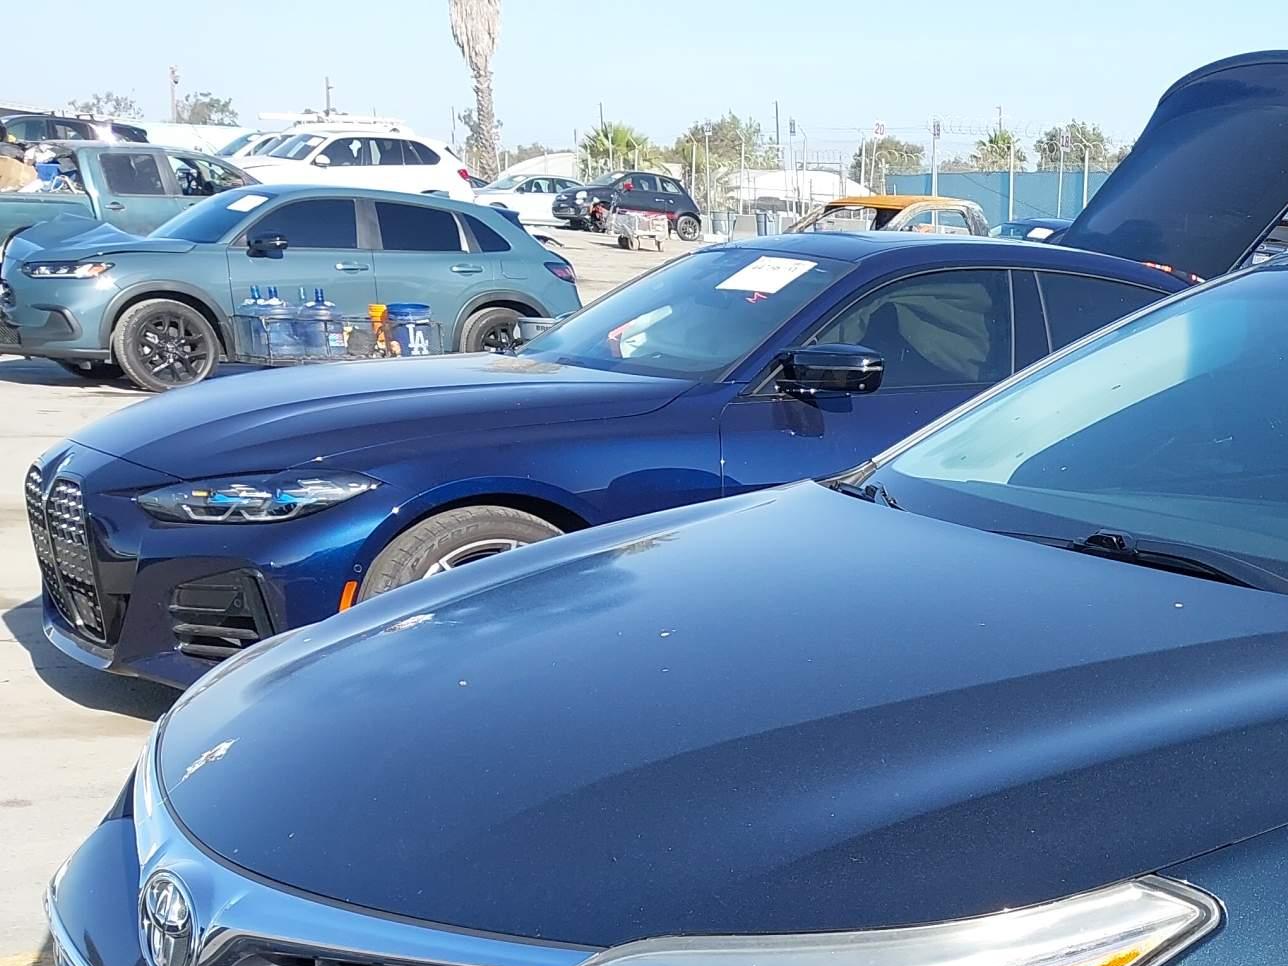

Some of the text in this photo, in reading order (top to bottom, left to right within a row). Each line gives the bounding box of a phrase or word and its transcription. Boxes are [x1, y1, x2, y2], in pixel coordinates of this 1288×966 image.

[875, 122, 885, 136] 20
[1061, 135, 1070, 148] 18
[407, 324, 429, 355] LA
